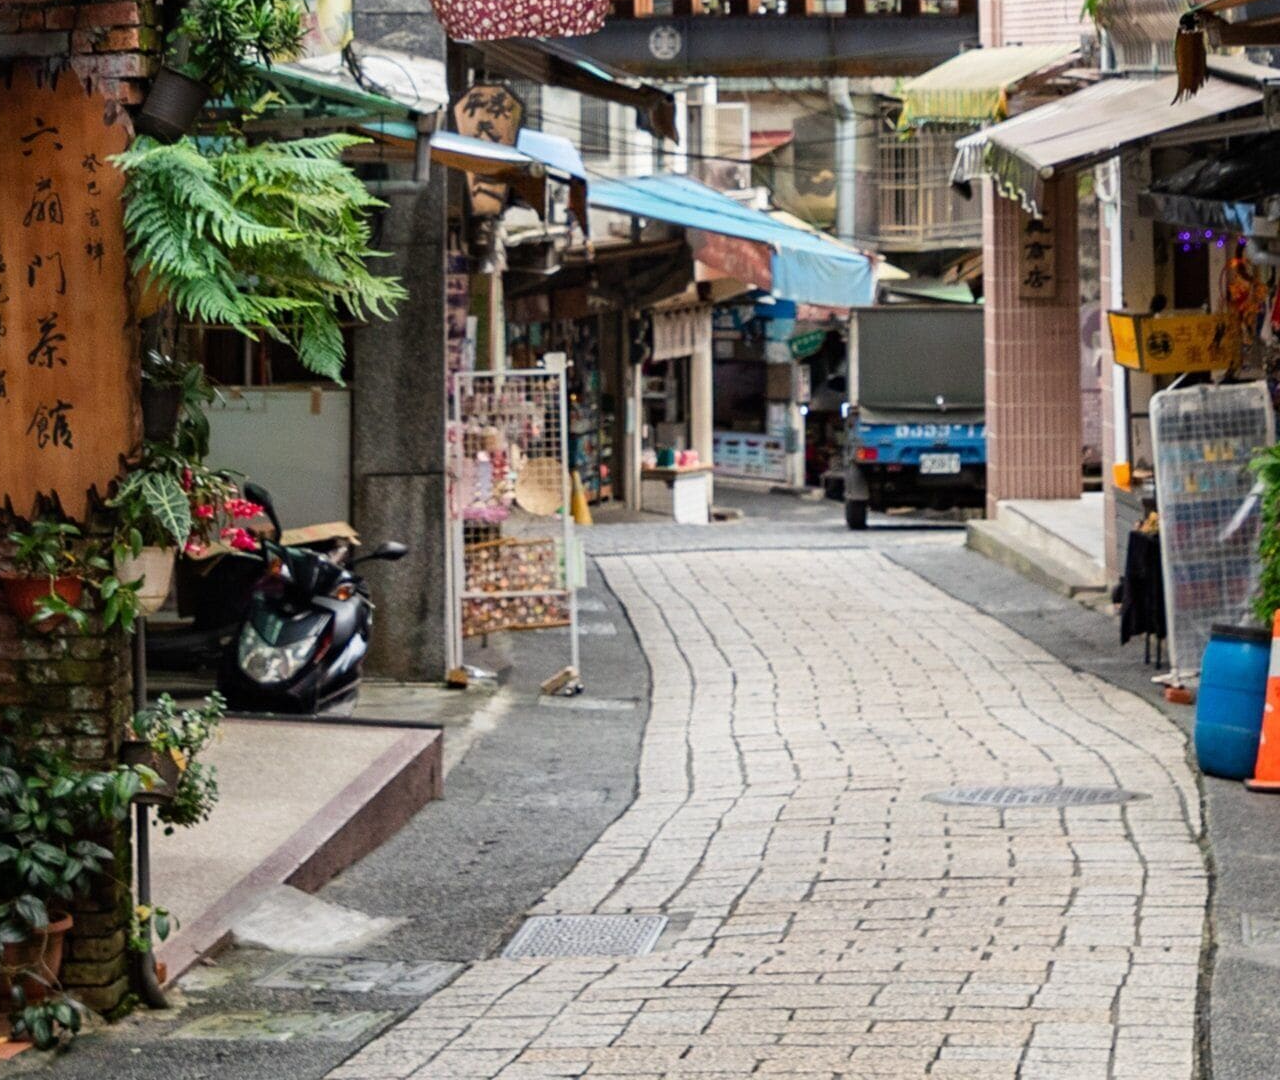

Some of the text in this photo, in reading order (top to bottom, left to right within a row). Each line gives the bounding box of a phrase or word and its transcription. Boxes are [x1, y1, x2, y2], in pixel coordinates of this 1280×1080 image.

[21, 118, 75, 450] 六扇門茶館
